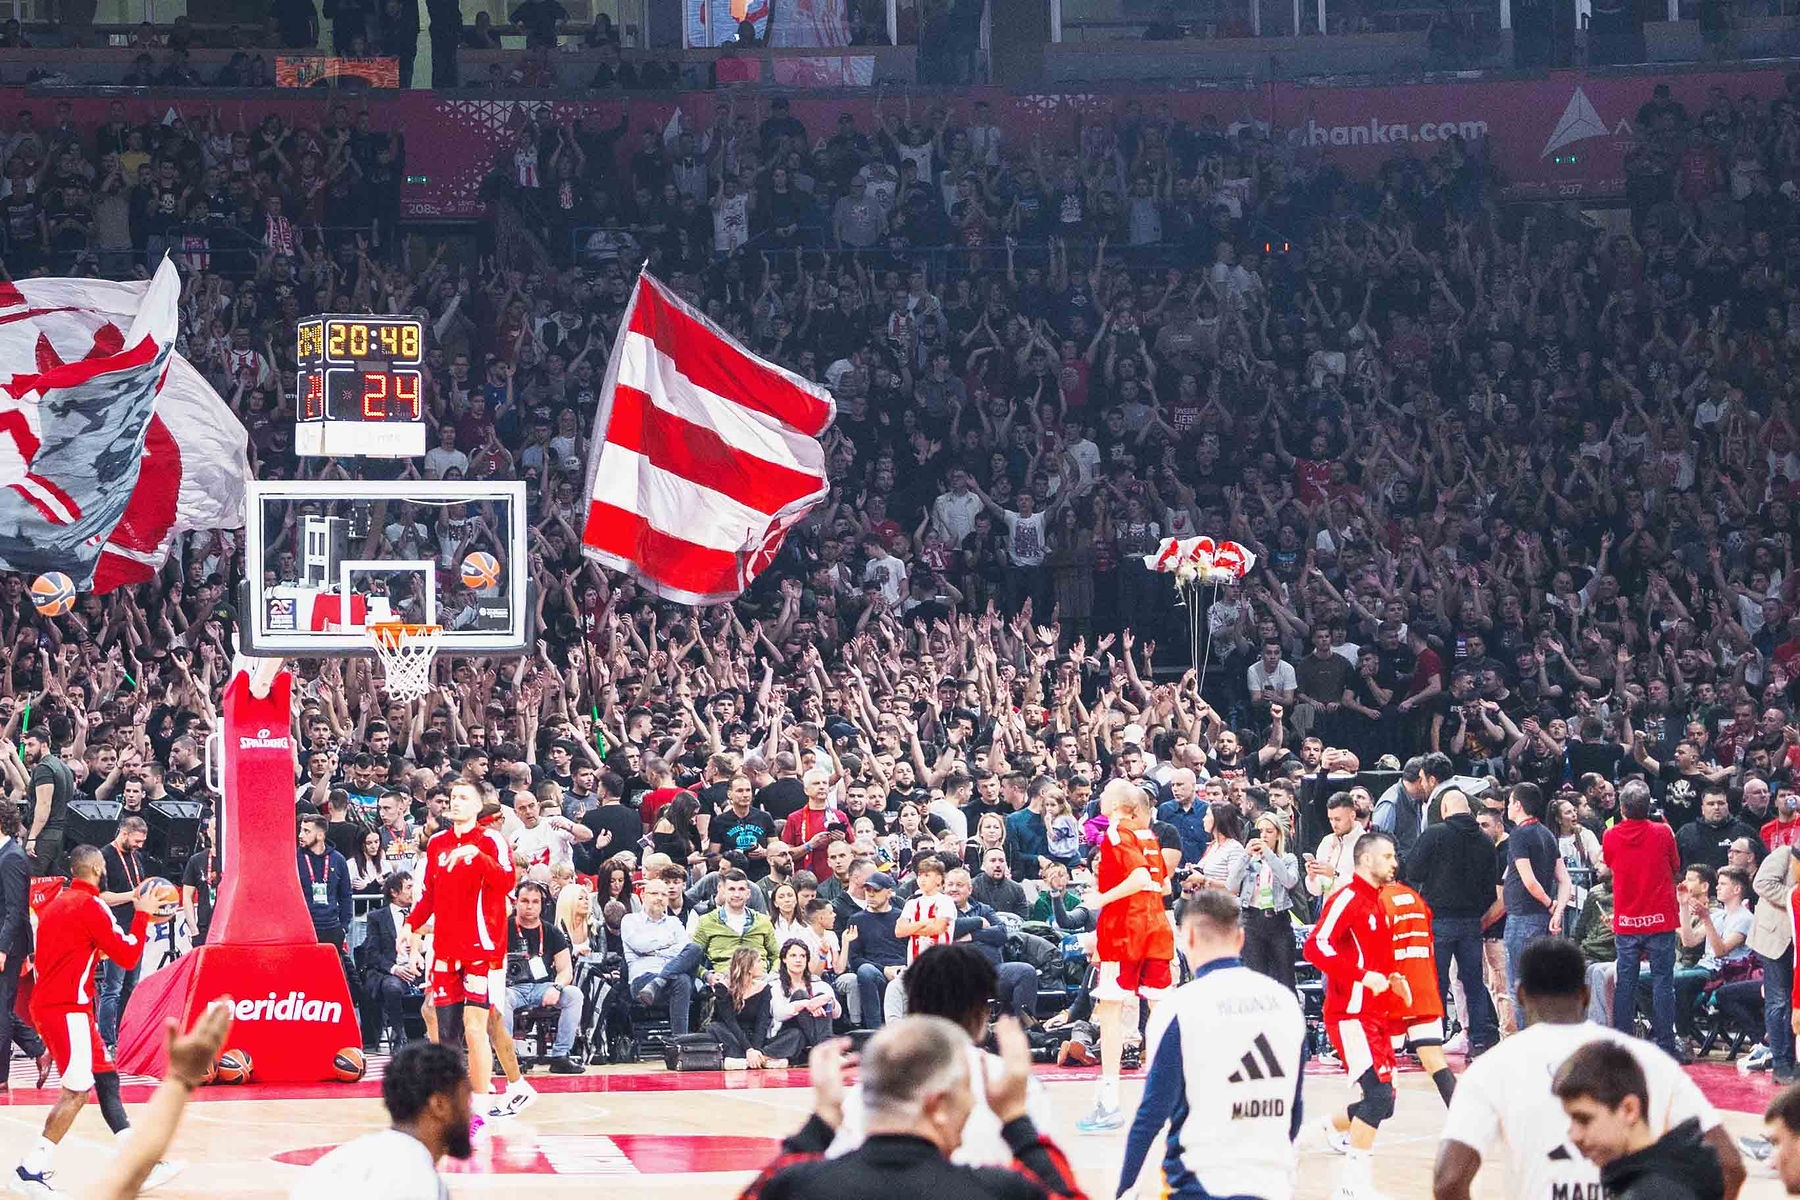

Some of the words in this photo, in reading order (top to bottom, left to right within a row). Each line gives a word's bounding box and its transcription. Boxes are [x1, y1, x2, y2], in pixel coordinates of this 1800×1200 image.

[329, 324, 419, 357] 20:48
[239, 736, 290, 750] SPALDING
[1618, 912, 1664, 927] Kappa
[1231, 1099, 1284, 1121] MADRID
